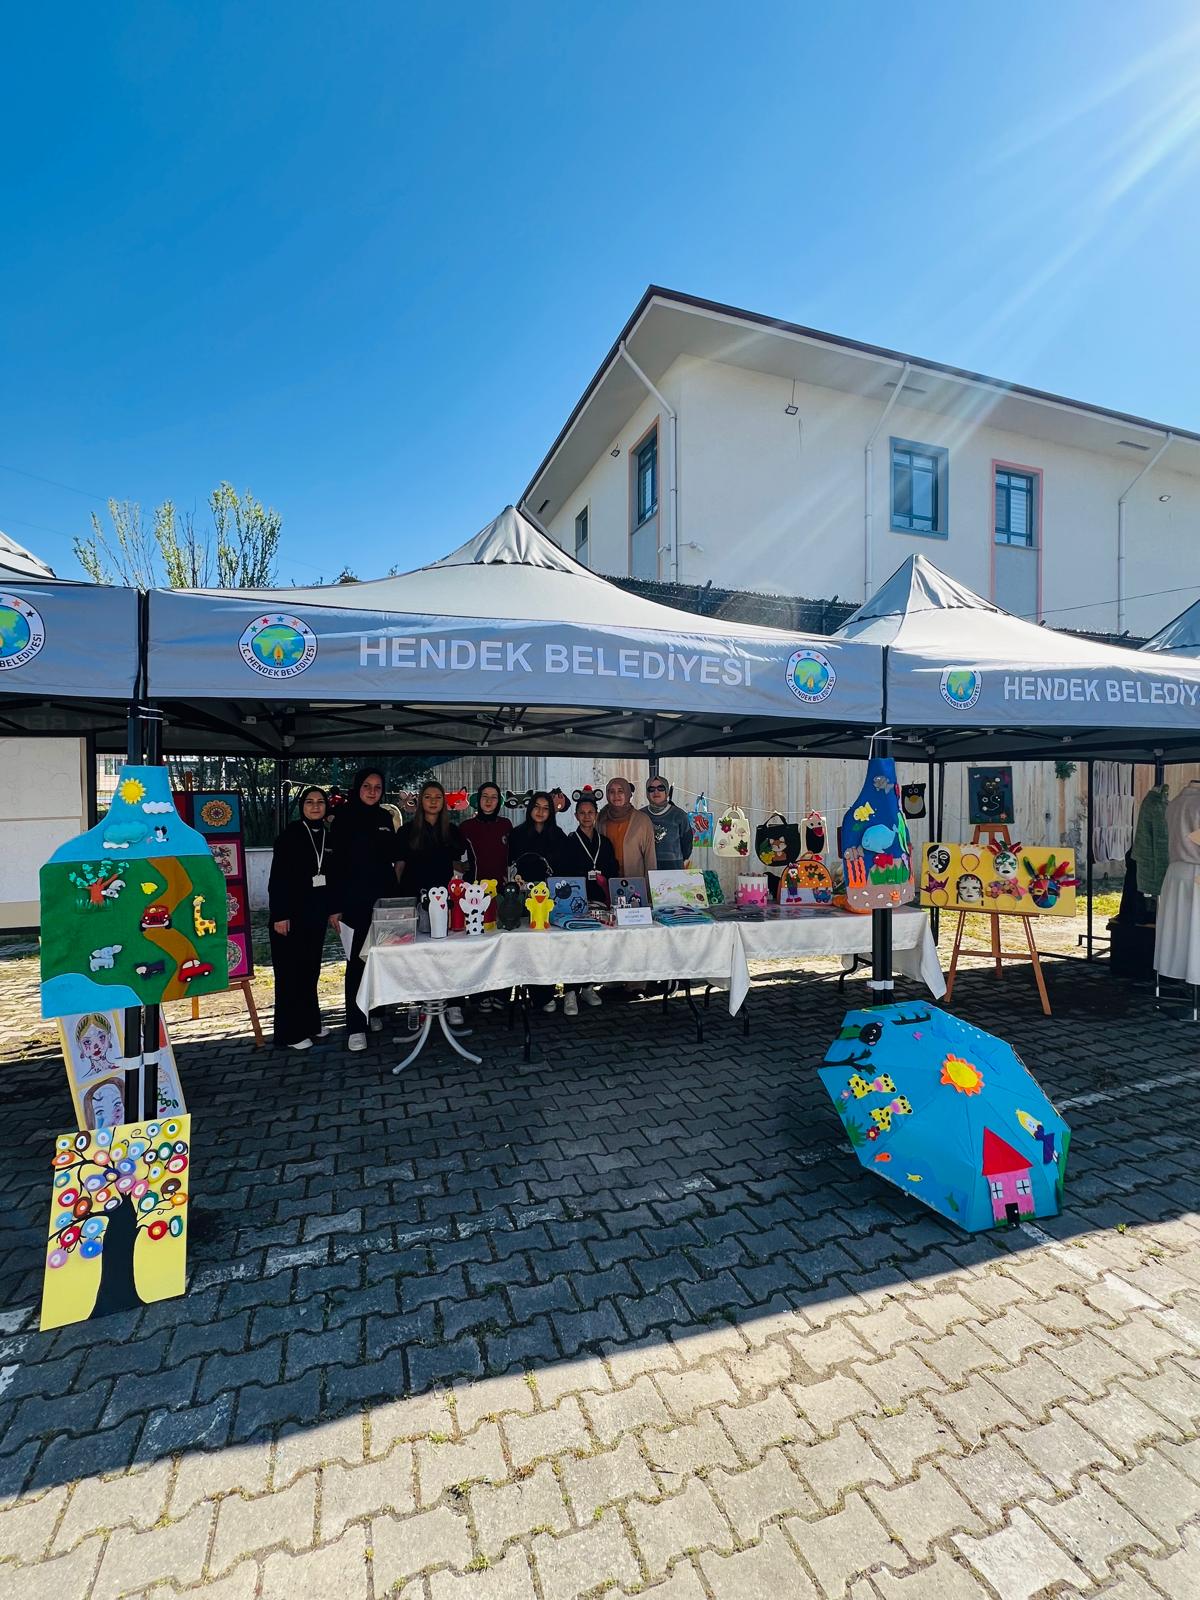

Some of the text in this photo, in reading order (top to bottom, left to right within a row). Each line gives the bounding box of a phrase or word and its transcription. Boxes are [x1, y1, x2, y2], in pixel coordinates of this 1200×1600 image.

[247, 656, 280, 677] HENDEK
[360, 636, 533, 672] HENDEK
[1004, 676, 1200, 706] HENDEK BELEDİY
